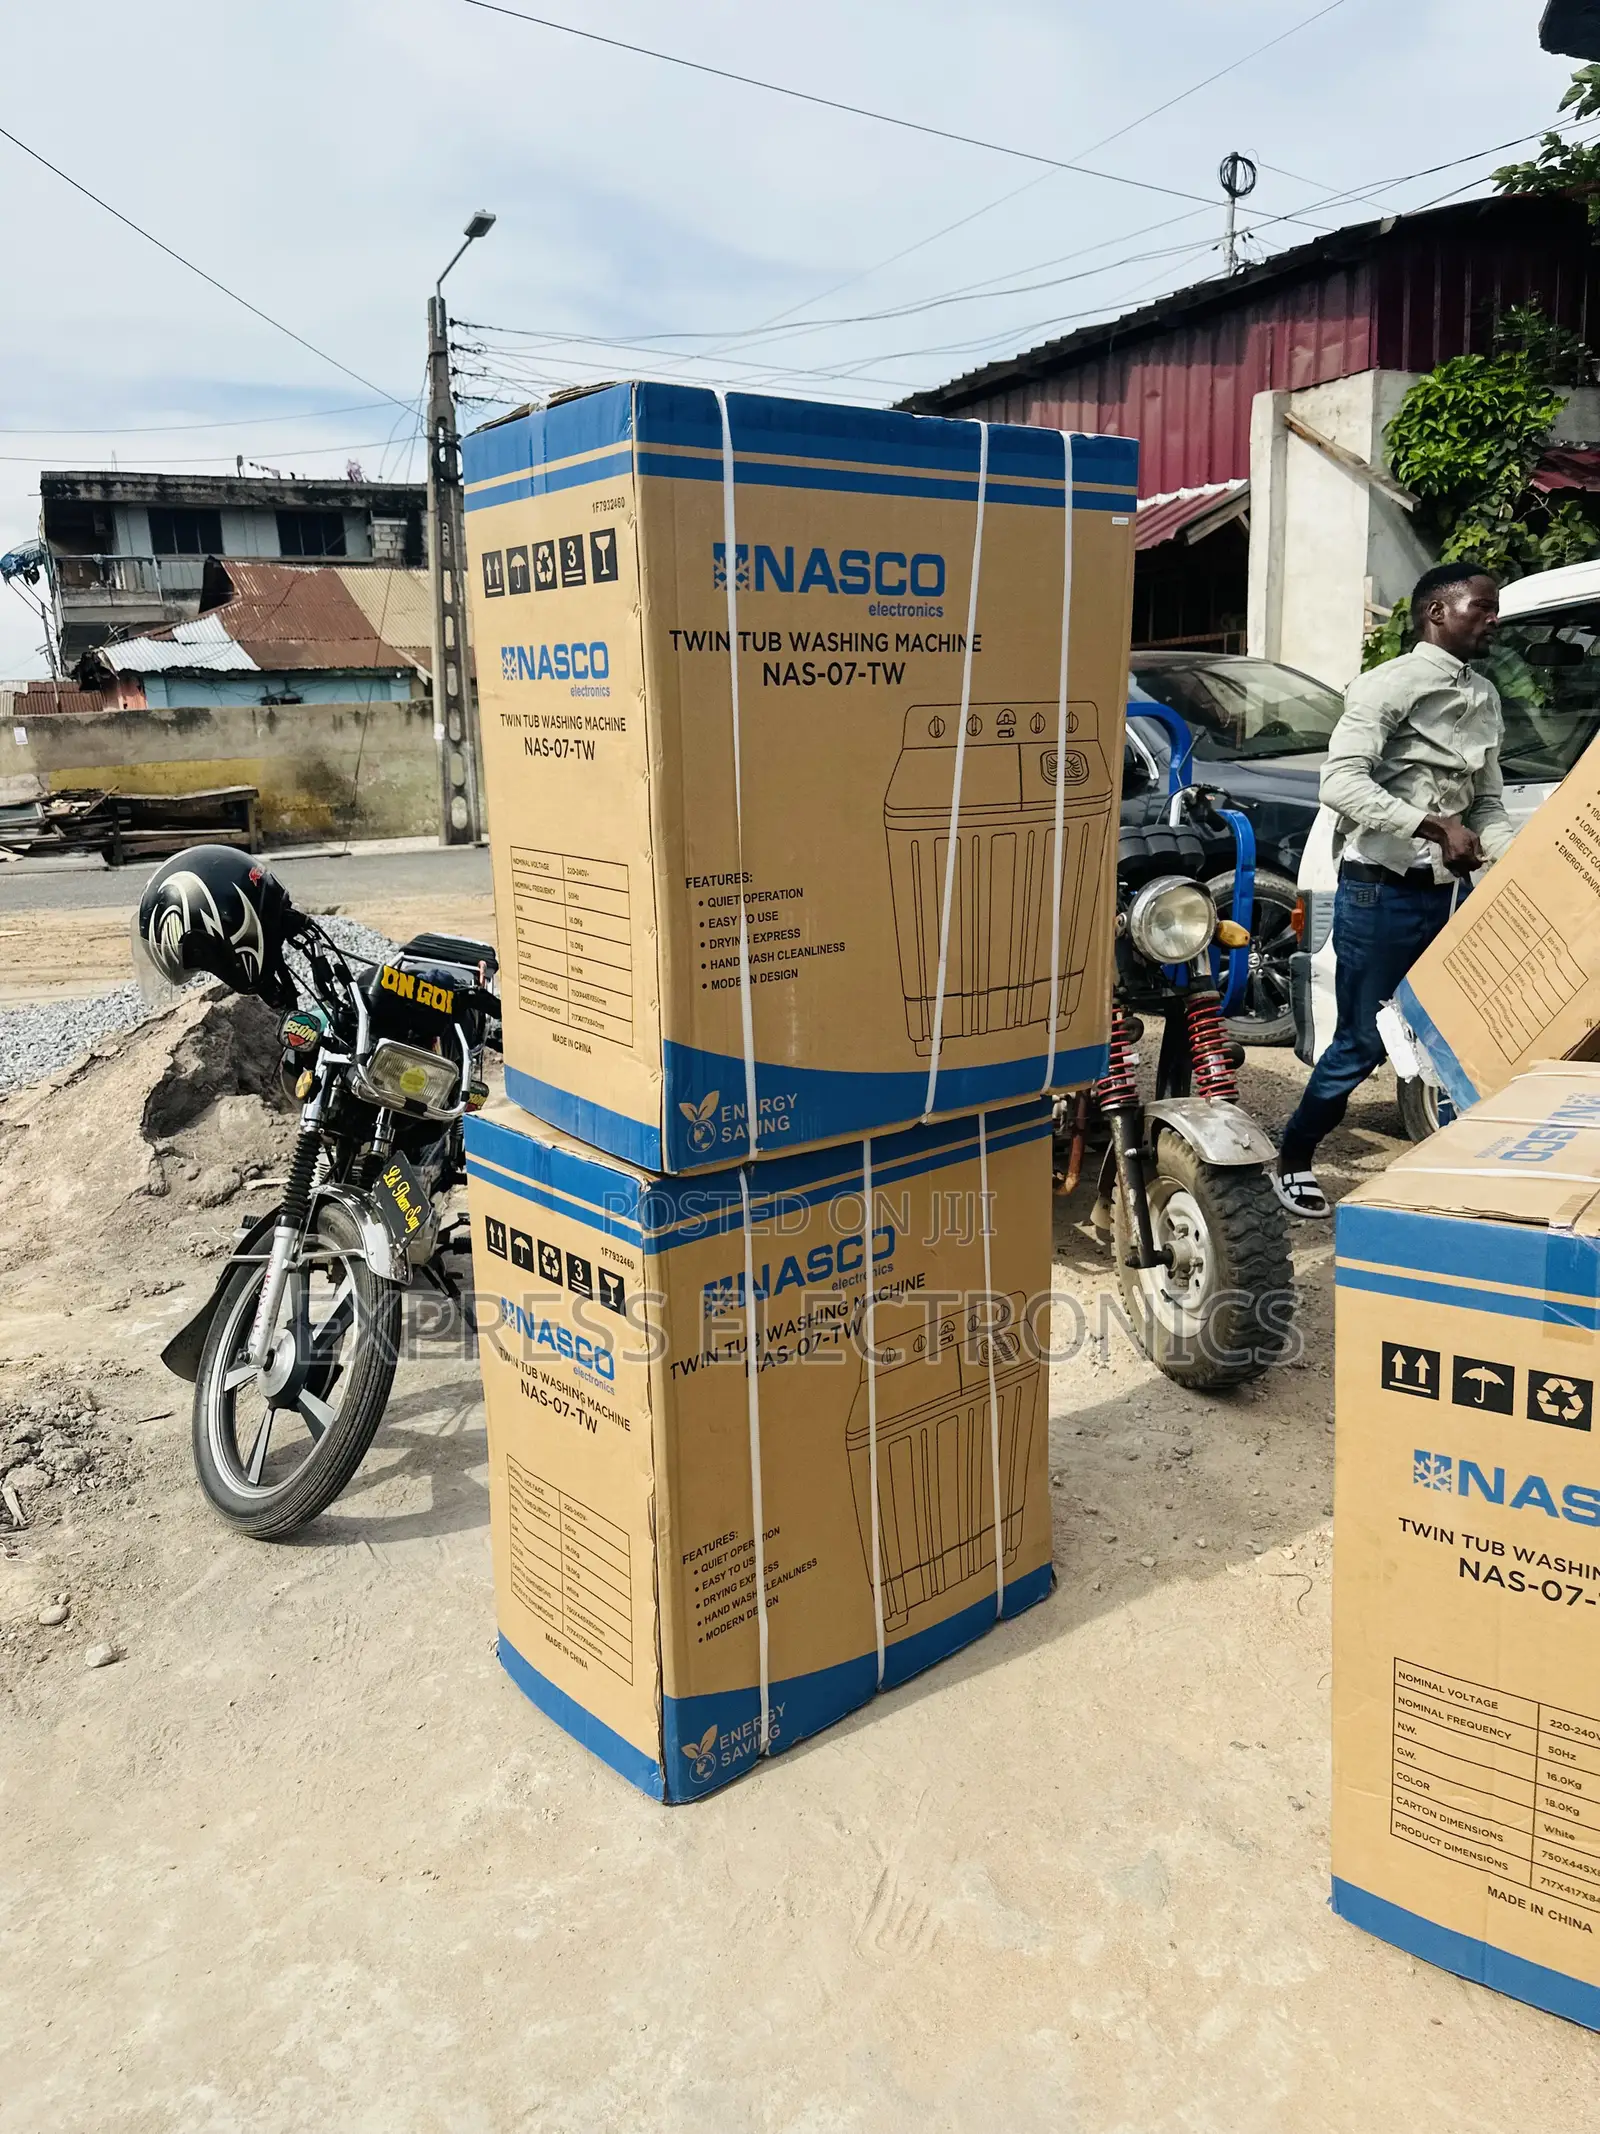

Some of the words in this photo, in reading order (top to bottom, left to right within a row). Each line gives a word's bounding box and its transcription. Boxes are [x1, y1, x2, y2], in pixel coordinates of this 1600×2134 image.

[592, 496, 625, 513] 1F7932460
[754, 545, 945, 597] NASCO
[869, 601, 944, 618] electronics
[669, 630, 730, 652] TWIN
[738, 631, 782, 651] TUB
[789, 632, 888, 652] WASHING
[517, 641, 609, 680] NASCO
[763, 662, 906, 686] NAS-07-TW
[571, 685, 610, 697] electronics
[501, 713, 522, 727] TWIN
[524, 714, 540, 728] TUB
[541, 715, 582, 730] WASHING
[585, 717, 626, 732] MACHINE
[524, 737, 595, 760] NAS-07-TW
[1579, 820, 1596, 838] LOW
[1558, 845, 1584, 873] ENERGY
[1569, 833, 1592, 858] DIRECT
[531, 861, 549, 870] VOLTAGE
[686, 872, 753, 889] FEATURES:
[708, 895, 740, 908] QUIET
[743, 888, 804, 903] OPERATION
[709, 916, 737, 928] EASY
[758, 911, 779, 923] USE
[753, 928, 800, 944] EXPRESS
[710, 956, 740, 970] HAND
[778, 942, 845, 961] CLEANLINESS
[711, 975, 757, 990] MODEN
[760, 969, 798, 983] DESIGN
[552, 1033, 567, 1046] MADE
[568, 1040, 573, 1048] IN
[574, 1041, 592, 1054] CHINA
[722, 1093, 798, 1122] ENRGY
[601, 1247, 634, 1270] 1F7932460
[738, 1225, 895, 1308] NASCO
[516, 1307, 614, 1381] NASCO
[670, 1347, 719, 1380] TWIN
[767, 1301, 848, 1346] WASHING
[573, 1367, 615, 1395] electronics
[521, 1361, 538, 1379] TUB
[540, 1372, 585, 1404] WASHING
[587, 1396, 631, 1432] MACHINE
[521, 1379, 598, 1434] NAS-07-TW
[1458, 1460, 1600, 1527] NAS
[682, 1530, 738, 1565] FEATURES:
[701, 1553, 728, 1573] QUIET
[730, 1526, 780, 1558] OPERTION
[1399, 1517, 1454, 1545] TWIN
[1462, 1534, 1505, 1556] TUB
[702, 1570, 726, 1590] EASY
[728, 1564, 740, 1576] TO
[703, 1584, 737, 1607] DRYING
[740, 1561, 779, 1588] EXPESS
[704, 1604, 730, 1624] HAND
[732, 1592, 757, 1609] WASH
[706, 1614, 744, 1642] MODERN
[747, 1595, 779, 1619] DEGN
[545, 1633, 562, 1650] MADE
[563, 1644, 569, 1655] IN
[570, 1651, 588, 1669] CHINA
[1398, 1671, 1445, 1694] NOMINAL
[1448, 1689, 1499, 1710] VOLTAGE
[1398, 1696, 1444, 1720] NOMINAL
[1447, 1714, 1511, 1741] FREQUENCY
[1548, 1745, 1577, 1761] 50Hz
[1397, 1772, 1430, 1791] COLOR
[1546, 1772, 1582, 1791] 16.0Kg
[1396, 1796, 1437, 1819] CARTON
[1440, 1813, 1504, 1842] DIMENSIONS
[1545, 1798, 1580, 1817] 18.0Kg
[1395, 1821, 1442, 1847] PRODUCT
[1444, 1842, 1509, 1871] DIMENSIONS
[1544, 1824, 1576, 1841] White
[1488, 1885, 1526, 1909] MADE
[1530, 1902, 1544, 1917] IN
[1548, 1909, 1593, 1934] CHINA
